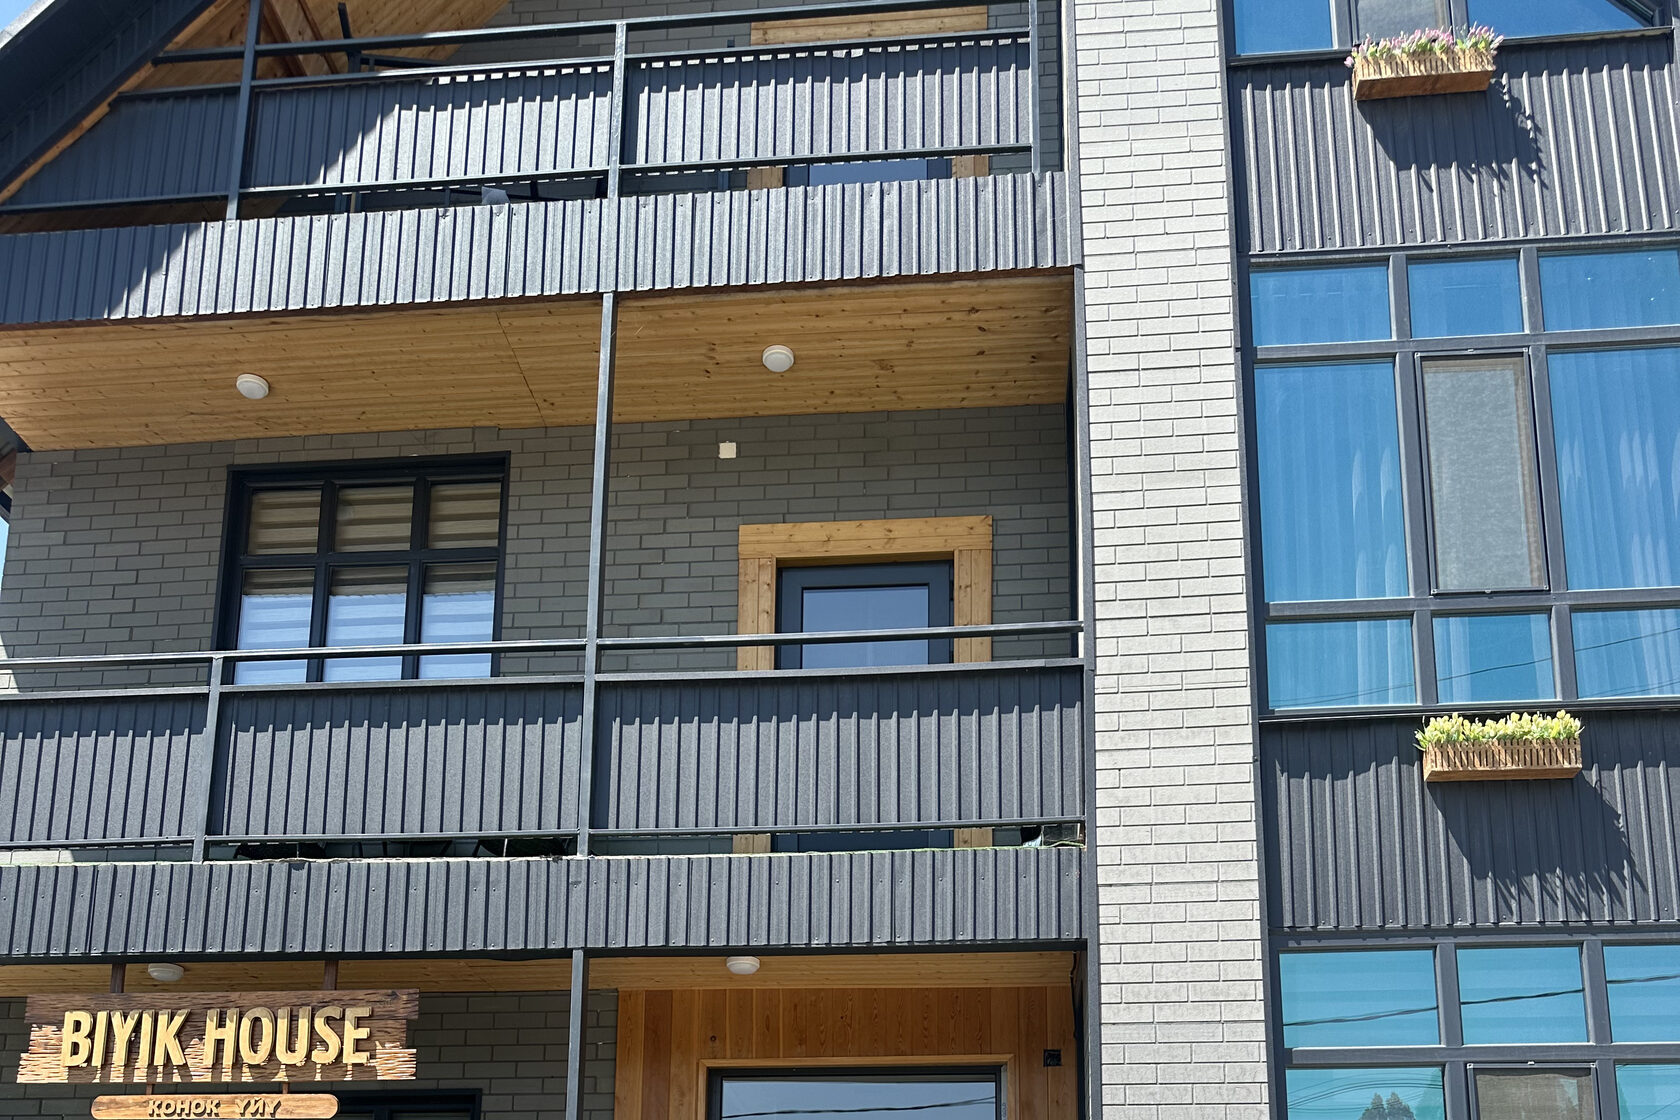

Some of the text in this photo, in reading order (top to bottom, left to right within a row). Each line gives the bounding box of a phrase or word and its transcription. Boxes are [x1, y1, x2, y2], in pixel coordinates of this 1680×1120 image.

[61, 1006, 372, 1068] BIYIK HOUSE
[148, 1098, 221, 1118] КОНОК
